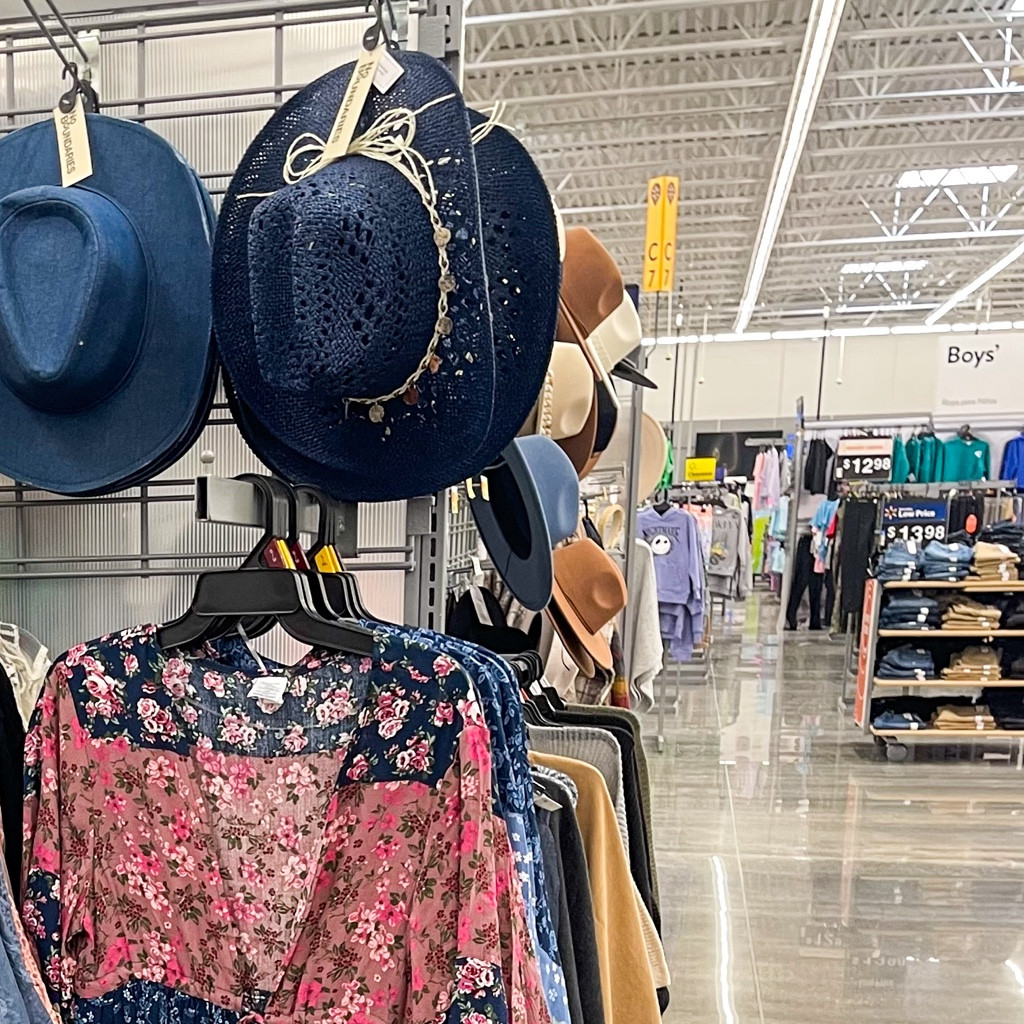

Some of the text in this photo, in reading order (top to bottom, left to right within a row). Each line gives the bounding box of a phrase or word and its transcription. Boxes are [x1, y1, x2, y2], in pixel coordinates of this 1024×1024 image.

[60, 115, 76, 175] BOUNDARIES
[648, 242, 658, 261] C
[648, 269, 656, 288] 7
